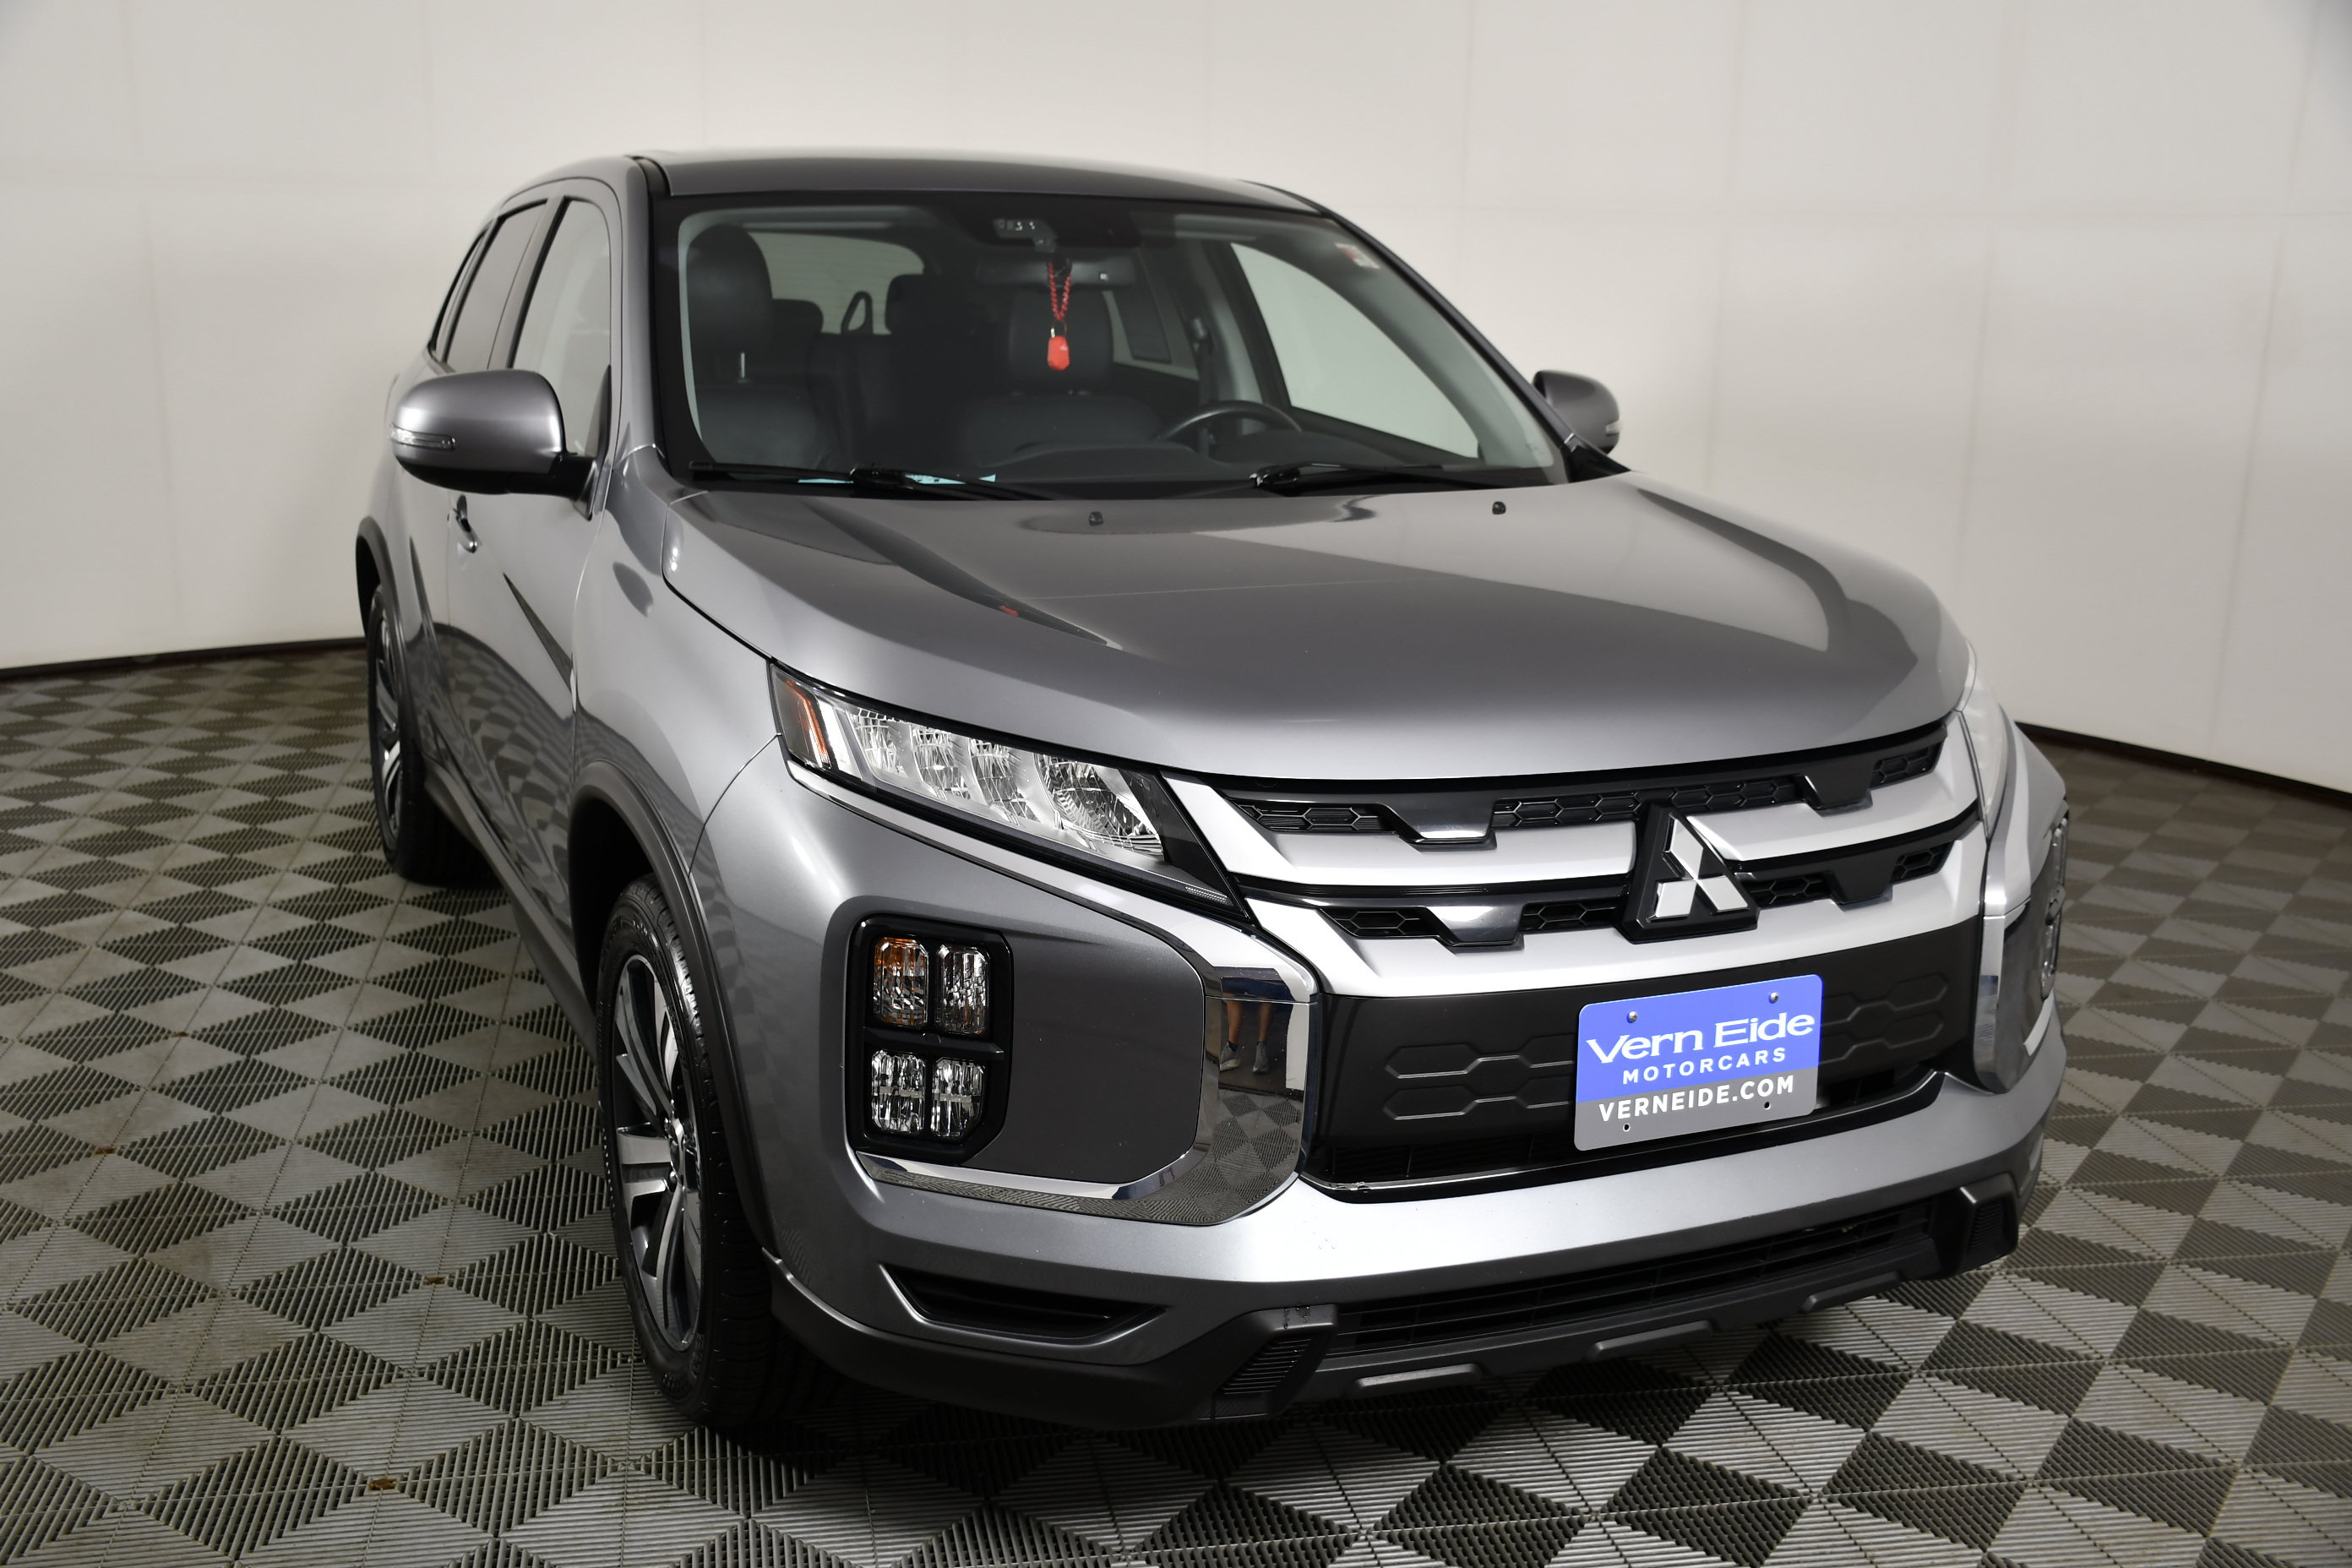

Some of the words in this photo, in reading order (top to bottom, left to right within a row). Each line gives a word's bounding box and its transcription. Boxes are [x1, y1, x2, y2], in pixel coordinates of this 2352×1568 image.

[1586, 1030, 1703, 1064] Vern
[1713, 1012, 1815, 1048] Eide
[1622, 1047, 1786, 1085] MOTORCARS
[1598, 1075, 1794, 1122] VERNEIDE.COM
